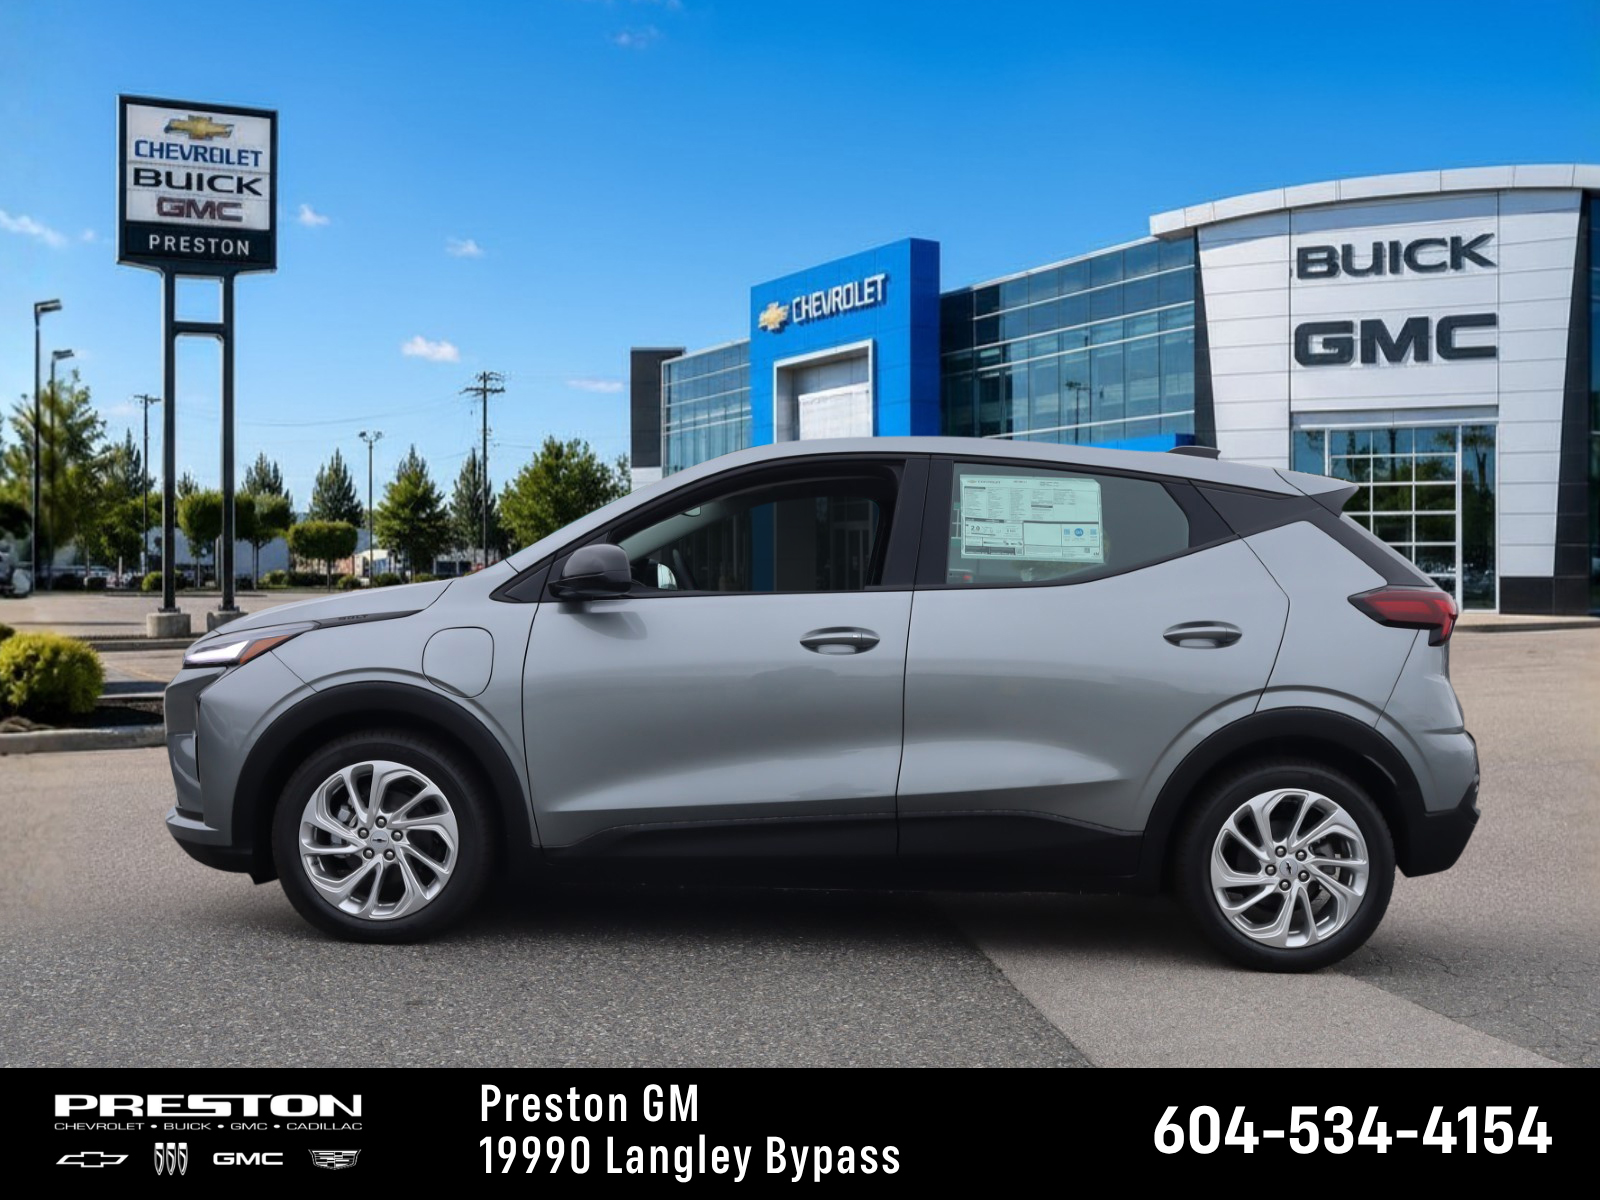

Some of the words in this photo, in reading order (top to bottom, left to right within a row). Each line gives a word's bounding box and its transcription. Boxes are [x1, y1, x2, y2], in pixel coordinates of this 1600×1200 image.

[134, 140, 263, 167] CHEVROLET
[133, 168, 263, 197] BUICK
[156, 196, 243, 222] GMC
[149, 234, 250, 256] PRESTON
[1297, 232, 1498, 280] BUICK
[791, 272, 887, 324] CHEVROLET
[1294, 313, 1498, 367] GMC
